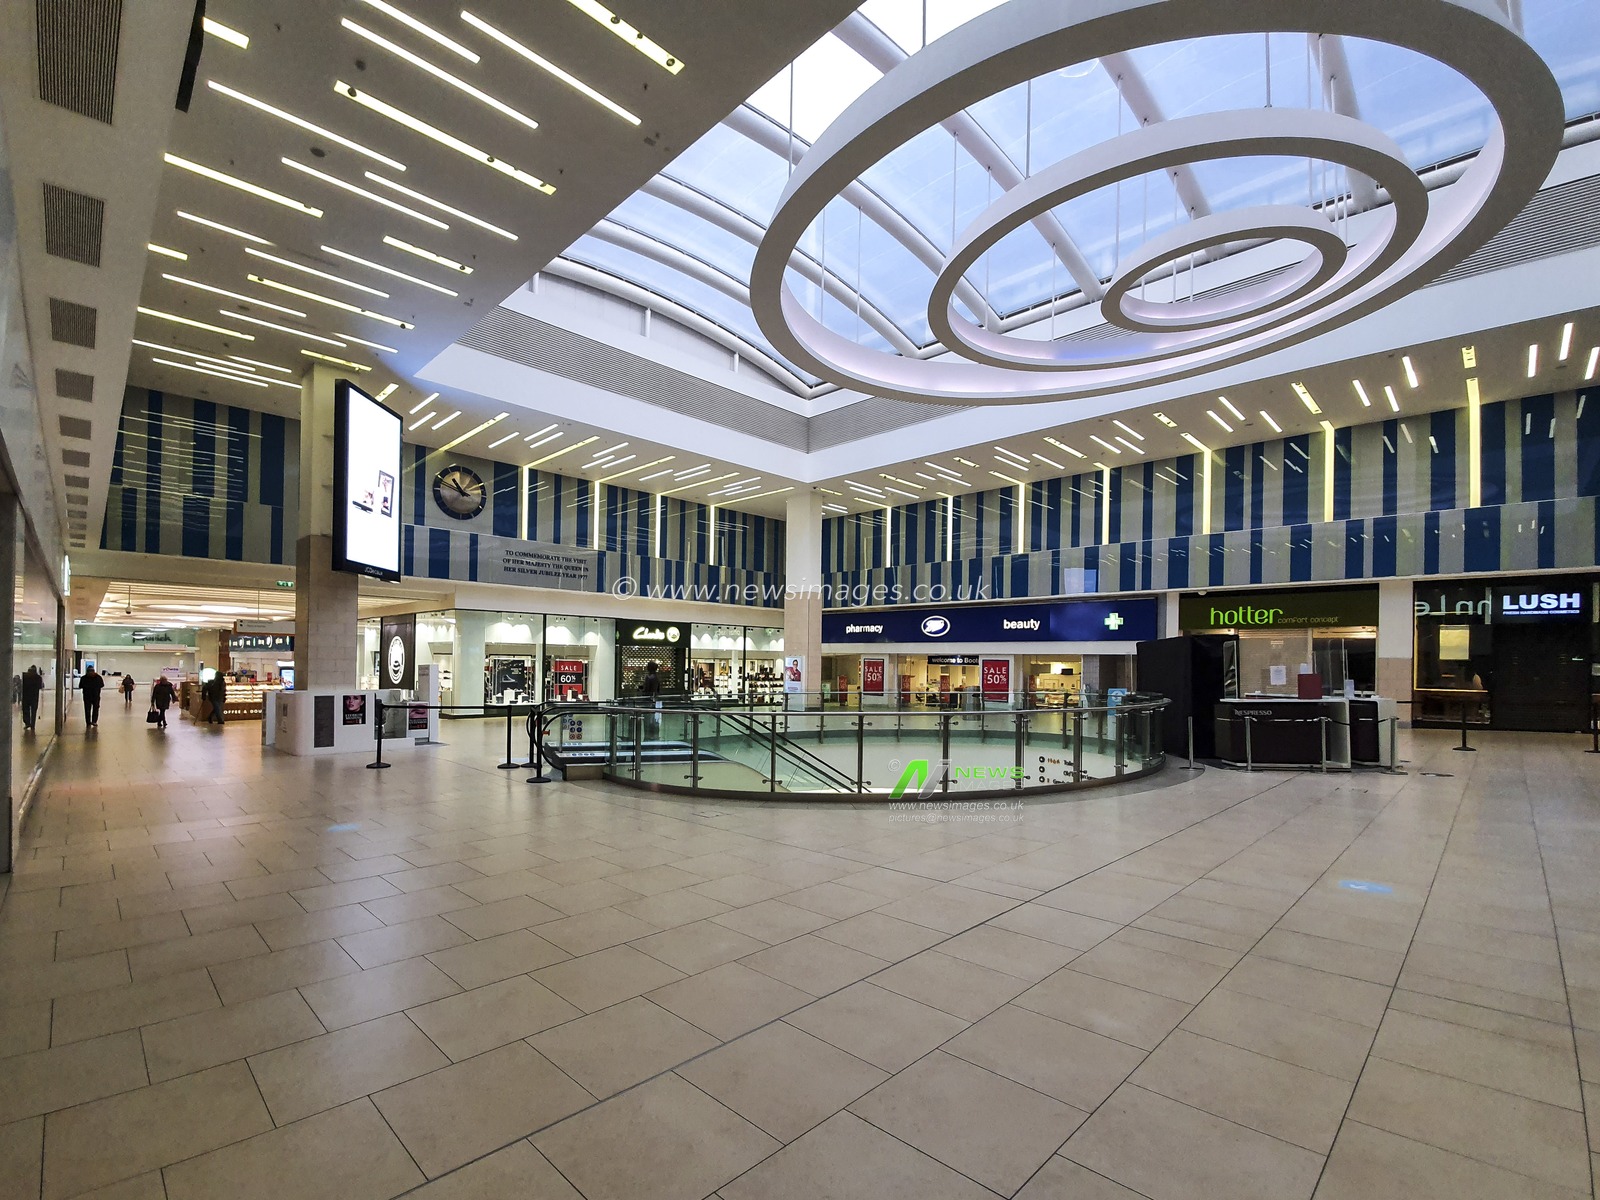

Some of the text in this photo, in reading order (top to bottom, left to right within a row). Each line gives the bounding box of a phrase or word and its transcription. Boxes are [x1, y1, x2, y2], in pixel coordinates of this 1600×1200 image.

[514, 551, 561, 562] COMMEMORATE
[573, 557, 587, 565] VISIT
[503, 565, 516, 573] HER
[517, 567, 537, 575] SILVER
[538, 569, 561, 577] JUBILEE
[511, 558, 524, 566] HER
[525, 560, 551, 569] MAJESTY
[552, 562, 563, 570] THE
[563, 564, 582, 572] QUEEN
[1503, 592, 1580, 610] LUSH
[1210, 605, 1339, 625] hotter comfort concept
[845, 624, 884, 634] pharmacy
[1003, 618, 1041, 631] beauty
[983, 666, 1007, 674] SALE
[867, 673, 882, 682] 50%
[987, 674, 1007, 684] 50%
[1234, 708, 1273, 717] NESPRESSO
